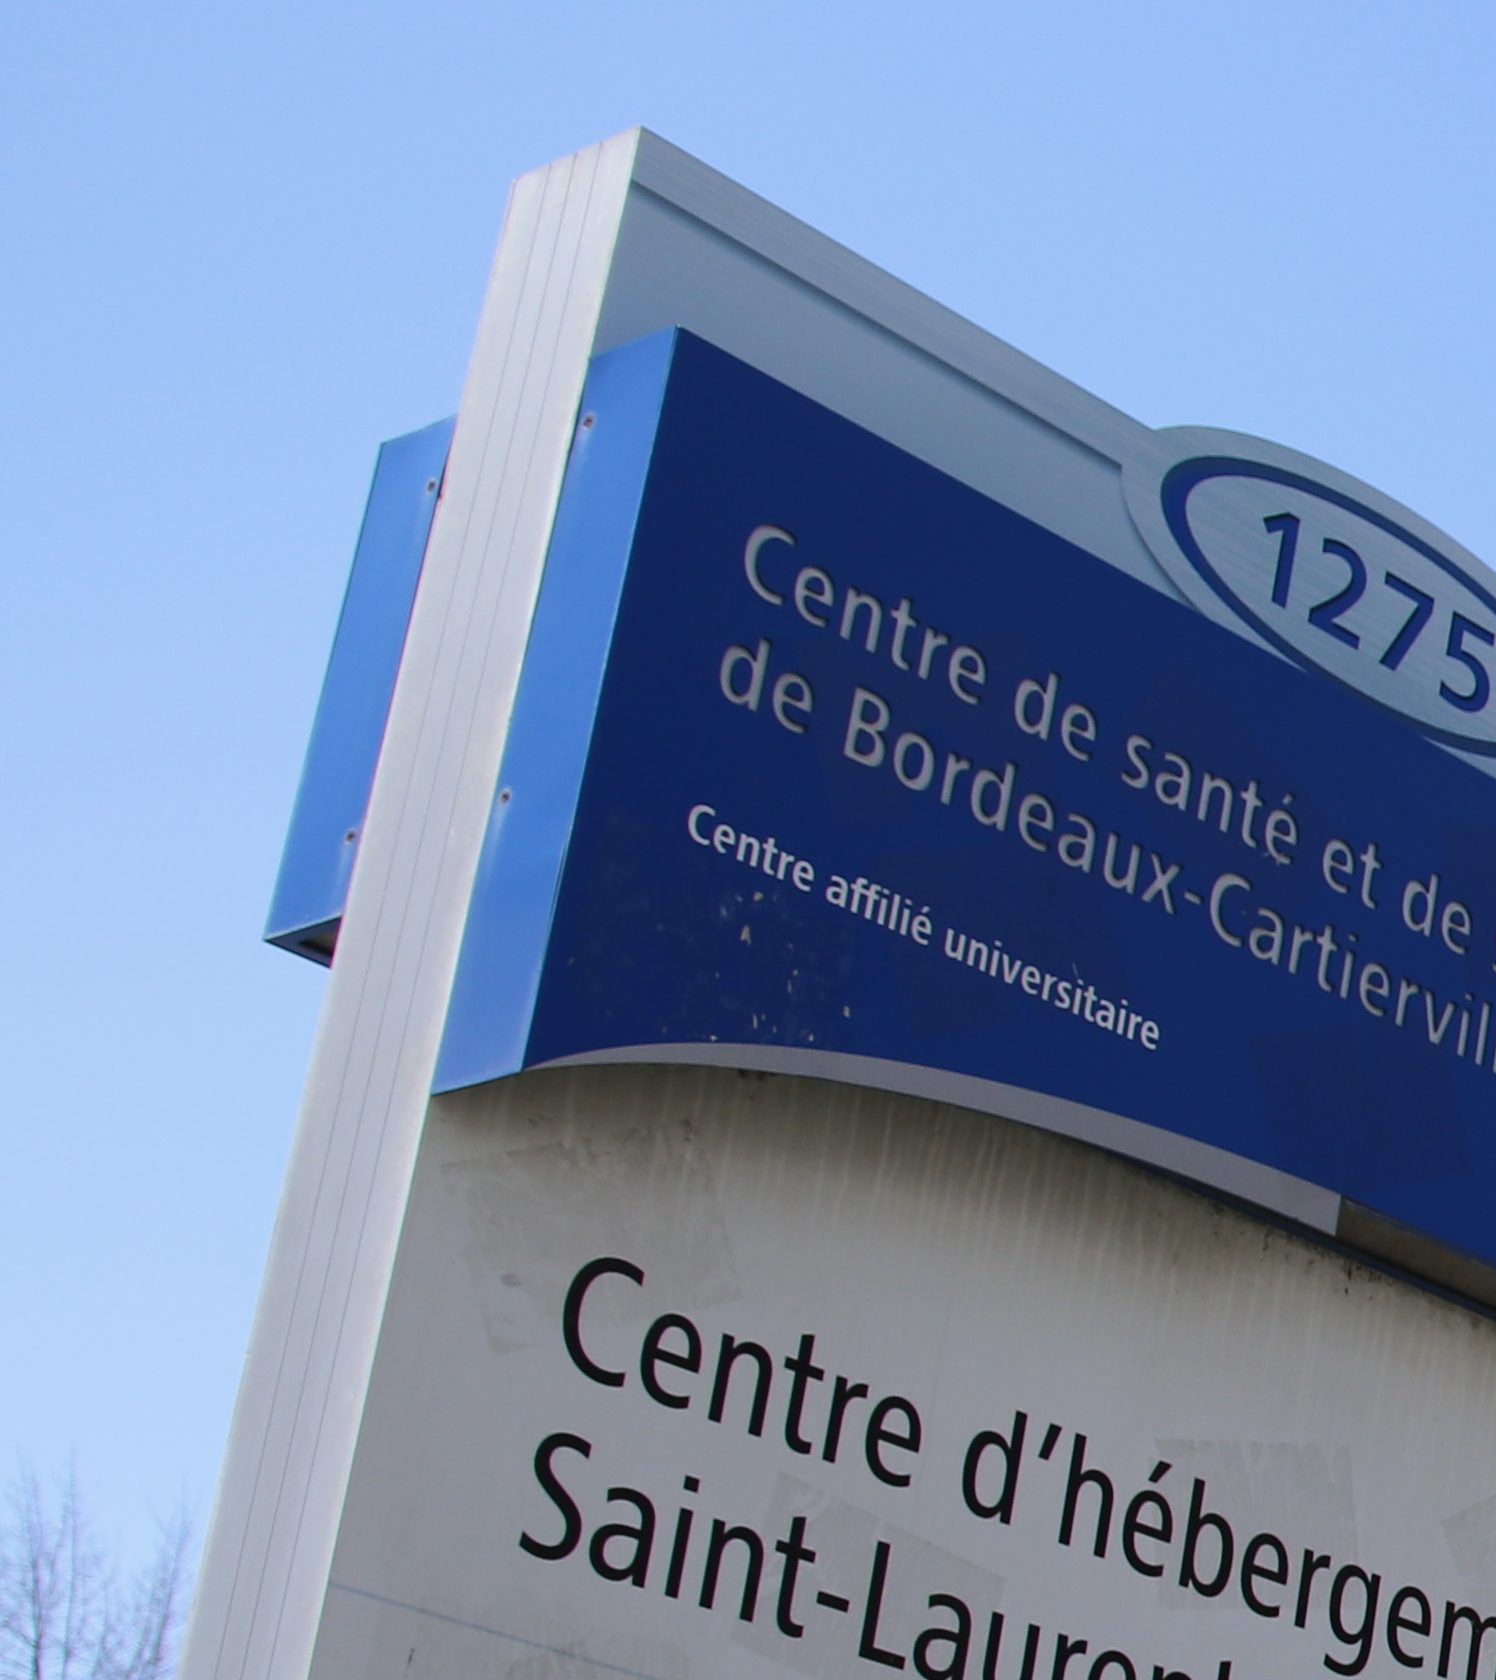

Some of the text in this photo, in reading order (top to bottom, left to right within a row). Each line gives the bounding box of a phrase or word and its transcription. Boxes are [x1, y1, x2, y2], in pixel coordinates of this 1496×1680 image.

[719, 638, 814, 733] de
[743, 523, 987, 705] Centre
[1013, 671, 1098, 762] de
[1121, 733, 1298, 865] santé
[1321, 838, 1382, 909] et
[1401, 873, 1473, 955] de
[687, 803, 1161, 1051] Centre affilié universitaire
[561, 1255, 925, 1489] Centre
